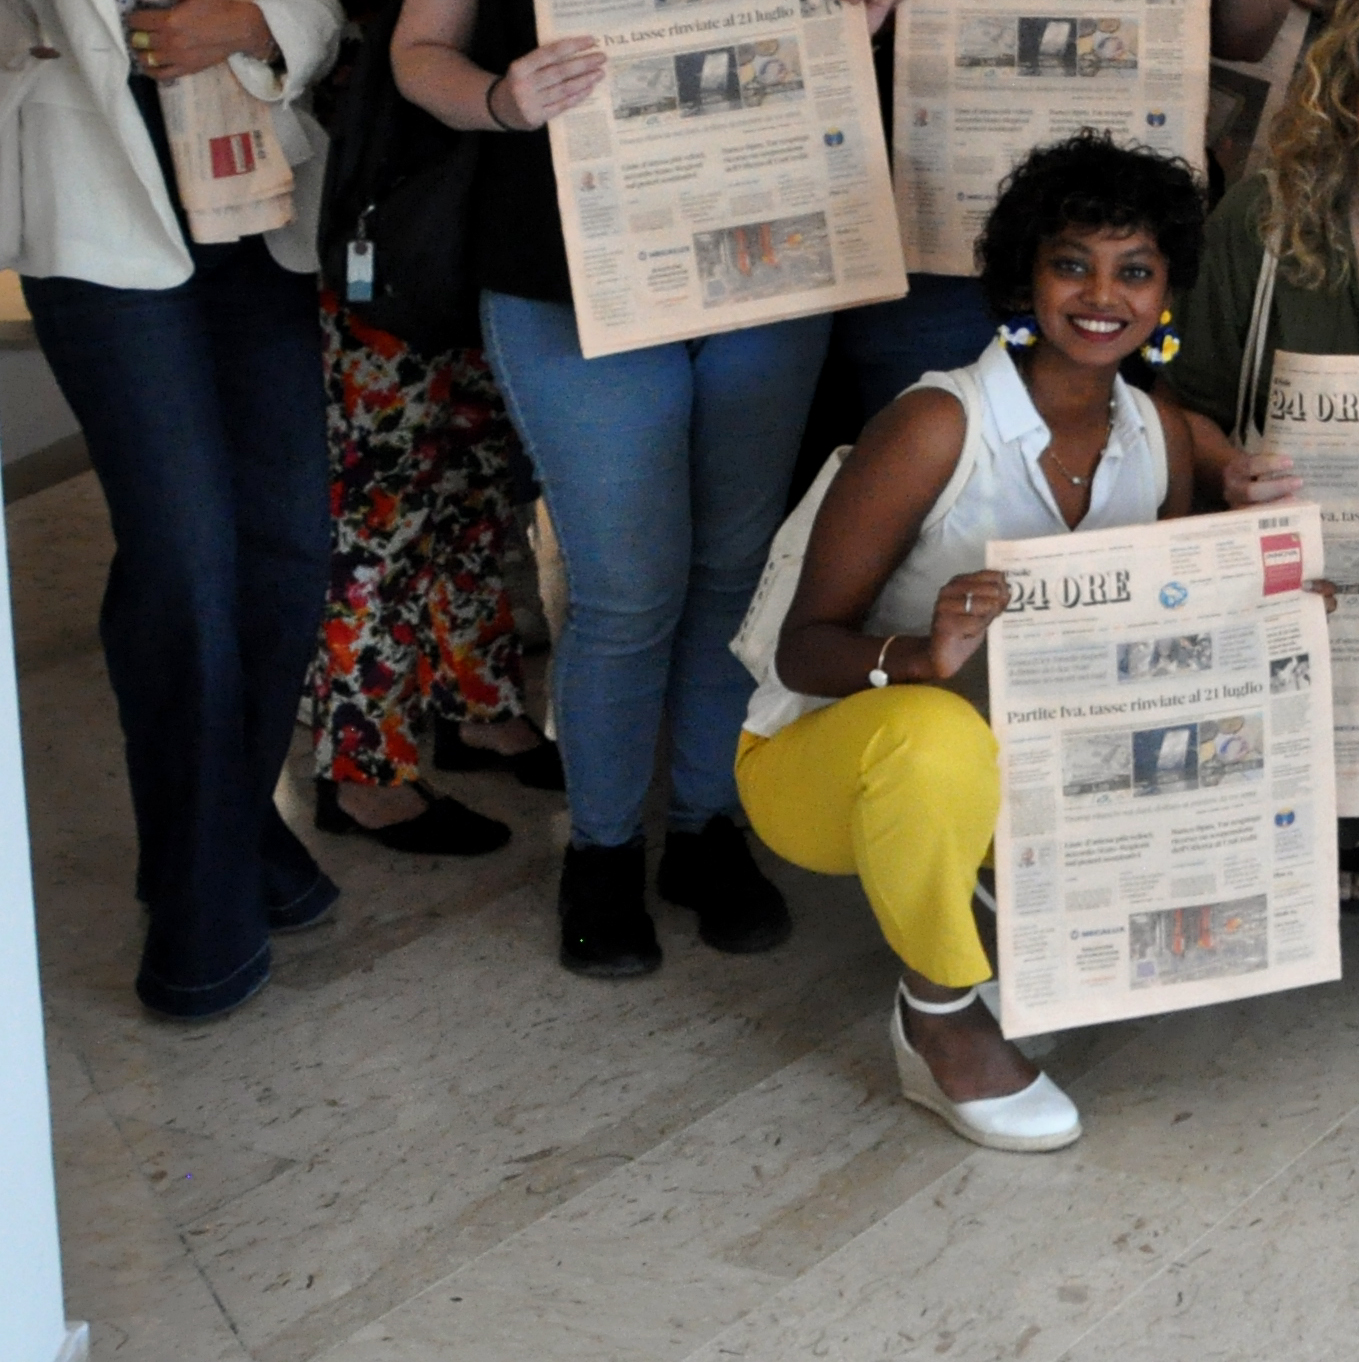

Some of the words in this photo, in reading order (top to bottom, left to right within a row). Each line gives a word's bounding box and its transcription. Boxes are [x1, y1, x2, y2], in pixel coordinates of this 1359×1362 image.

[668, 17, 720, 37] rinviate
[722, 15, 735, 28] al
[754, 6, 794, 25] luglio
[1271, 392, 1306, 421] 24
[1006, 577, 1052, 613] 24
[1059, 570, 1131, 608] ORE
[1007, 707, 1056, 724] Partite
[1060, 702, 1087, 721] Iva,
[1089, 700, 1128, 717] tasse
[1130, 691, 1186, 711] rinviate
[1188, 688, 1202, 703] al
[1204, 685, 1220, 701] 21
[1222, 681, 1263, 701] luglio
